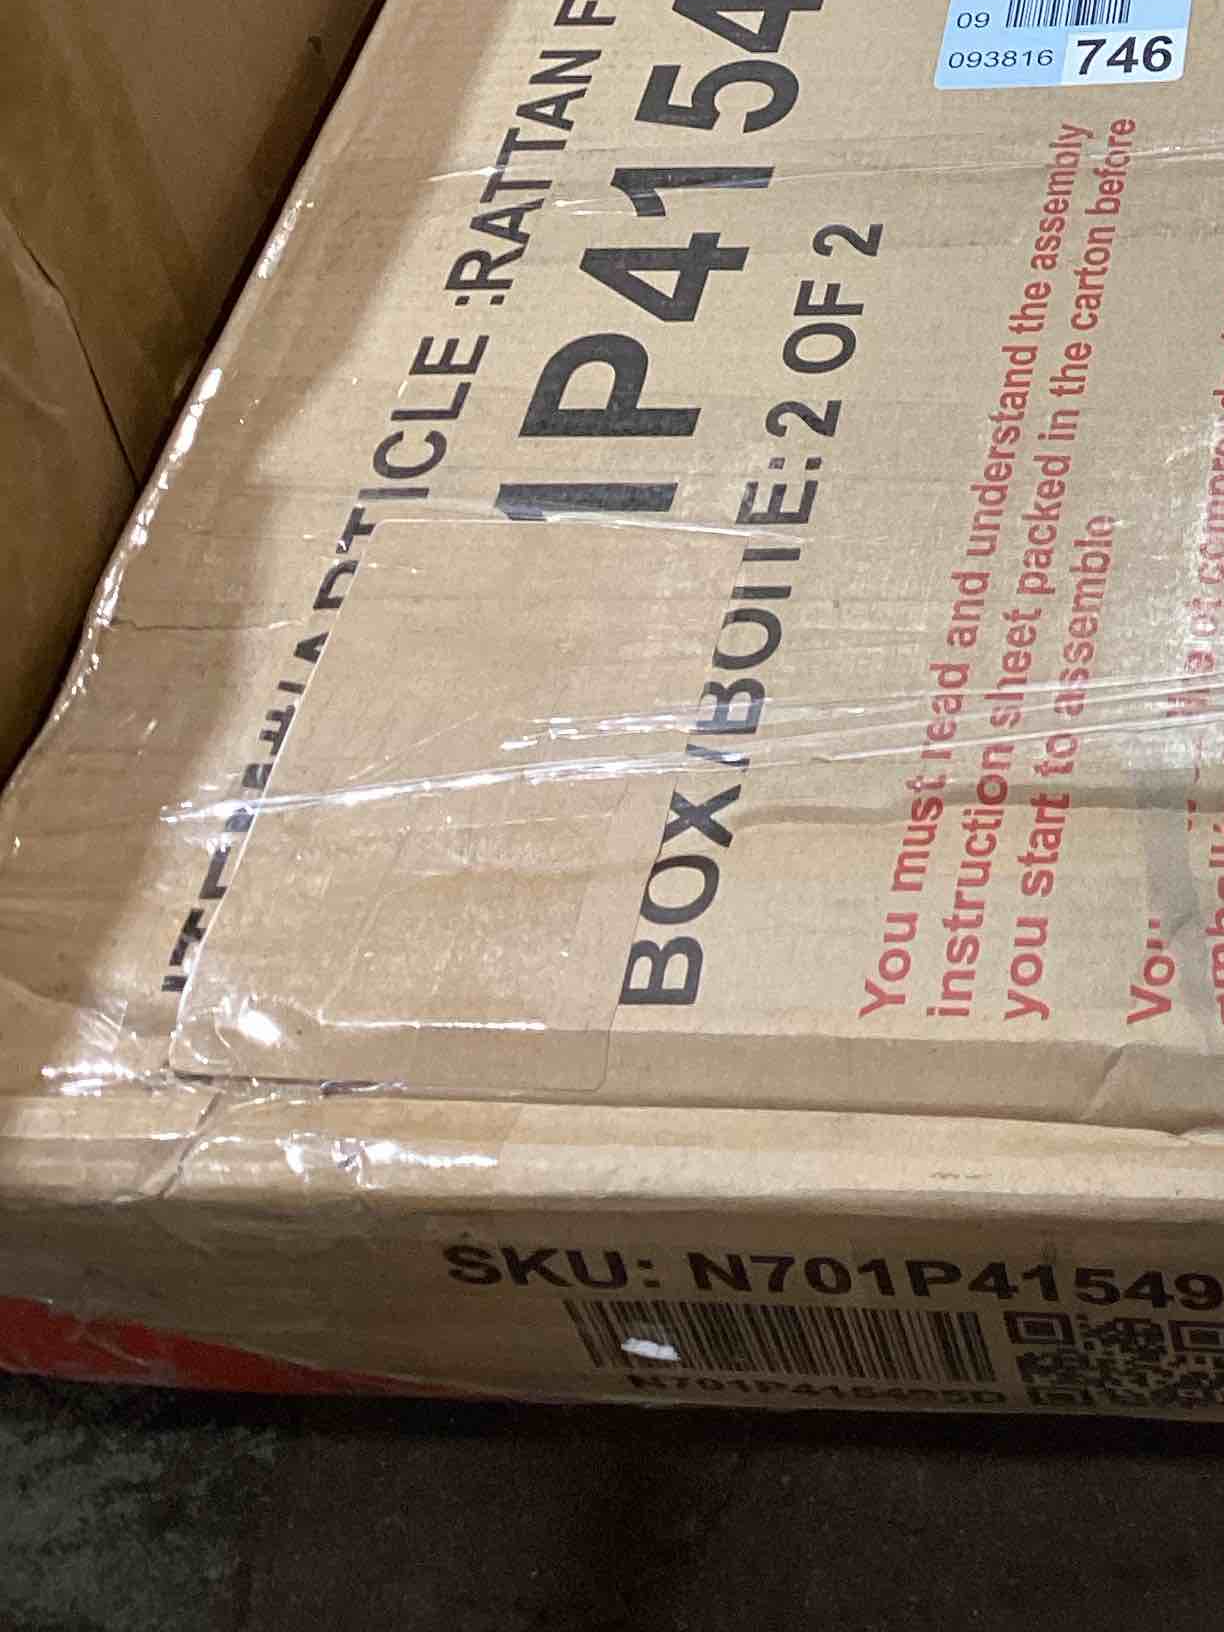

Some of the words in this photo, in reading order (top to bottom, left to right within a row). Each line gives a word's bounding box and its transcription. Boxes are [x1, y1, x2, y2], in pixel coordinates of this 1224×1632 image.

[948, 49, 1054, 70] 093816
[956, 11, 991, 29] 09
[1076, 34, 1174, 76] 746
[1030, 122, 1094, 271] assembly
[1084, 117, 1137, 216] before
[812, 223, 884, 257] 2
[1070, 224, 1116, 332] carton
[782, 279, 865, 374] OF
[1008, 281, 1053, 335] the
[1048, 341, 1093, 398] the
[966, 344, 1039, 558] understand
[1037, 408, 1080, 442] in
[1016, 454, 1072, 596] packed
[947, 570, 991, 649] and
[920, 662, 970, 761] read
[983, 607, 1042, 729] sheet
[1033, 732, 1078, 779] to
[890, 774, 945, 894] must
[926, 740, 1015, 1018] instruction
[1016, 791, 1071, 897] start
[858, 911, 919, 1019] You
[1004, 915, 1051, 1022] you
[1126, 918, 1176, 1025] Vo
[441, 1242, 659, 1290] SKU:
